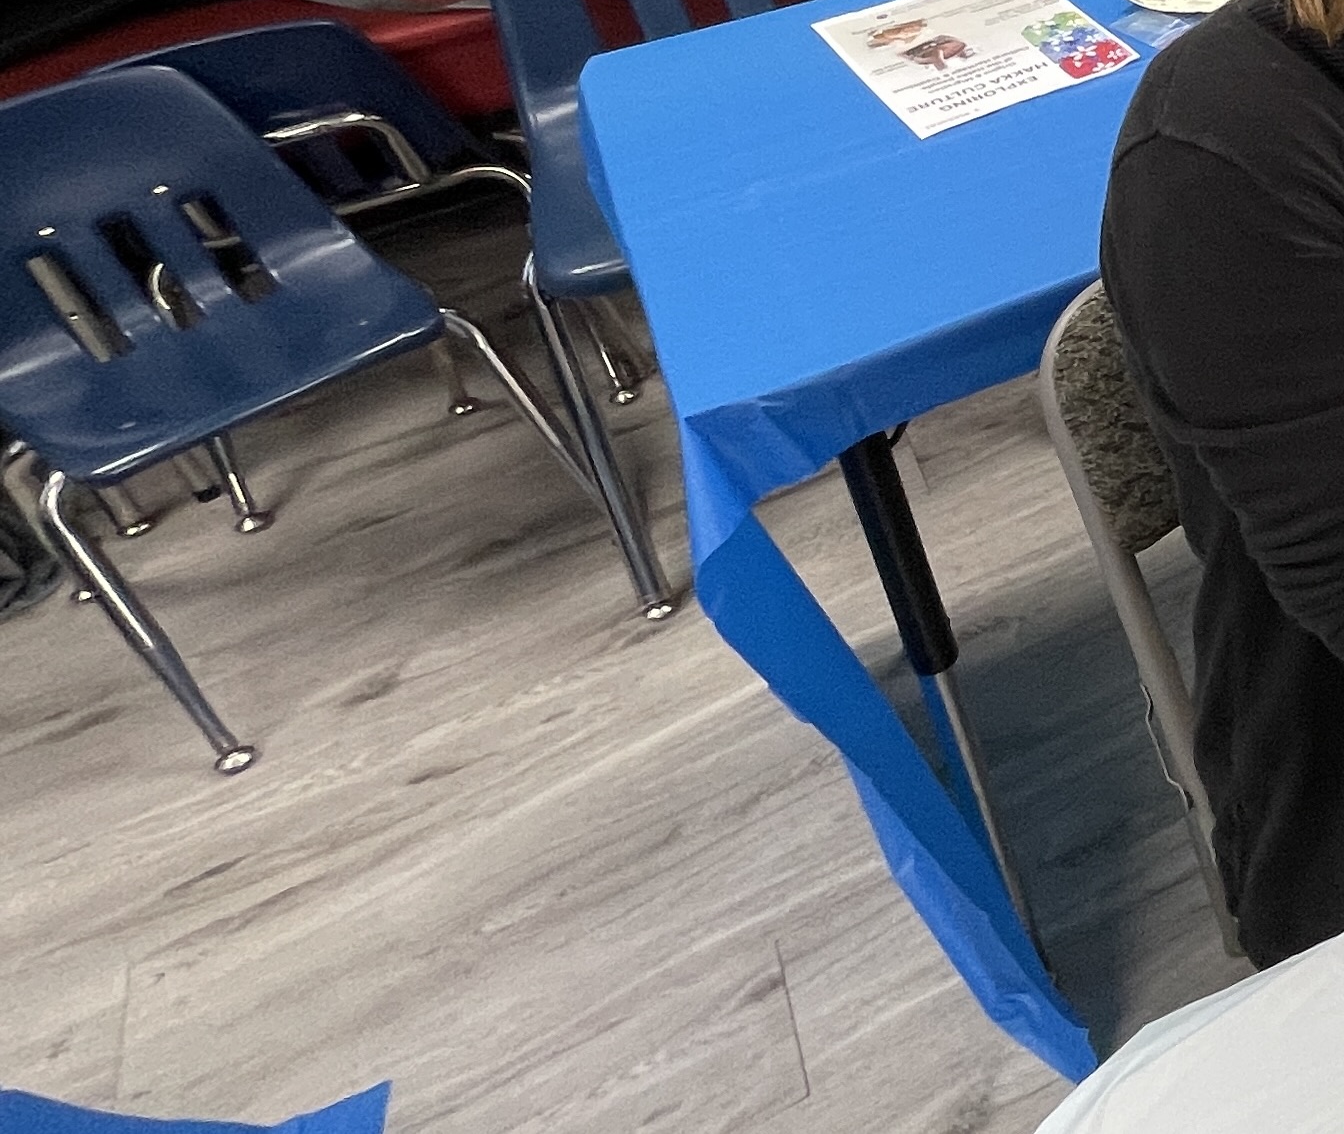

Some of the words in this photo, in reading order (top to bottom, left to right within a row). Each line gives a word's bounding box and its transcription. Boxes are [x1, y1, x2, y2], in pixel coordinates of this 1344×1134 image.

[990, 61, 1048, 84] HAKKA
[907, 83, 986, 113] CULTURE
[939, 75, 1038, 112] EXPLORING
